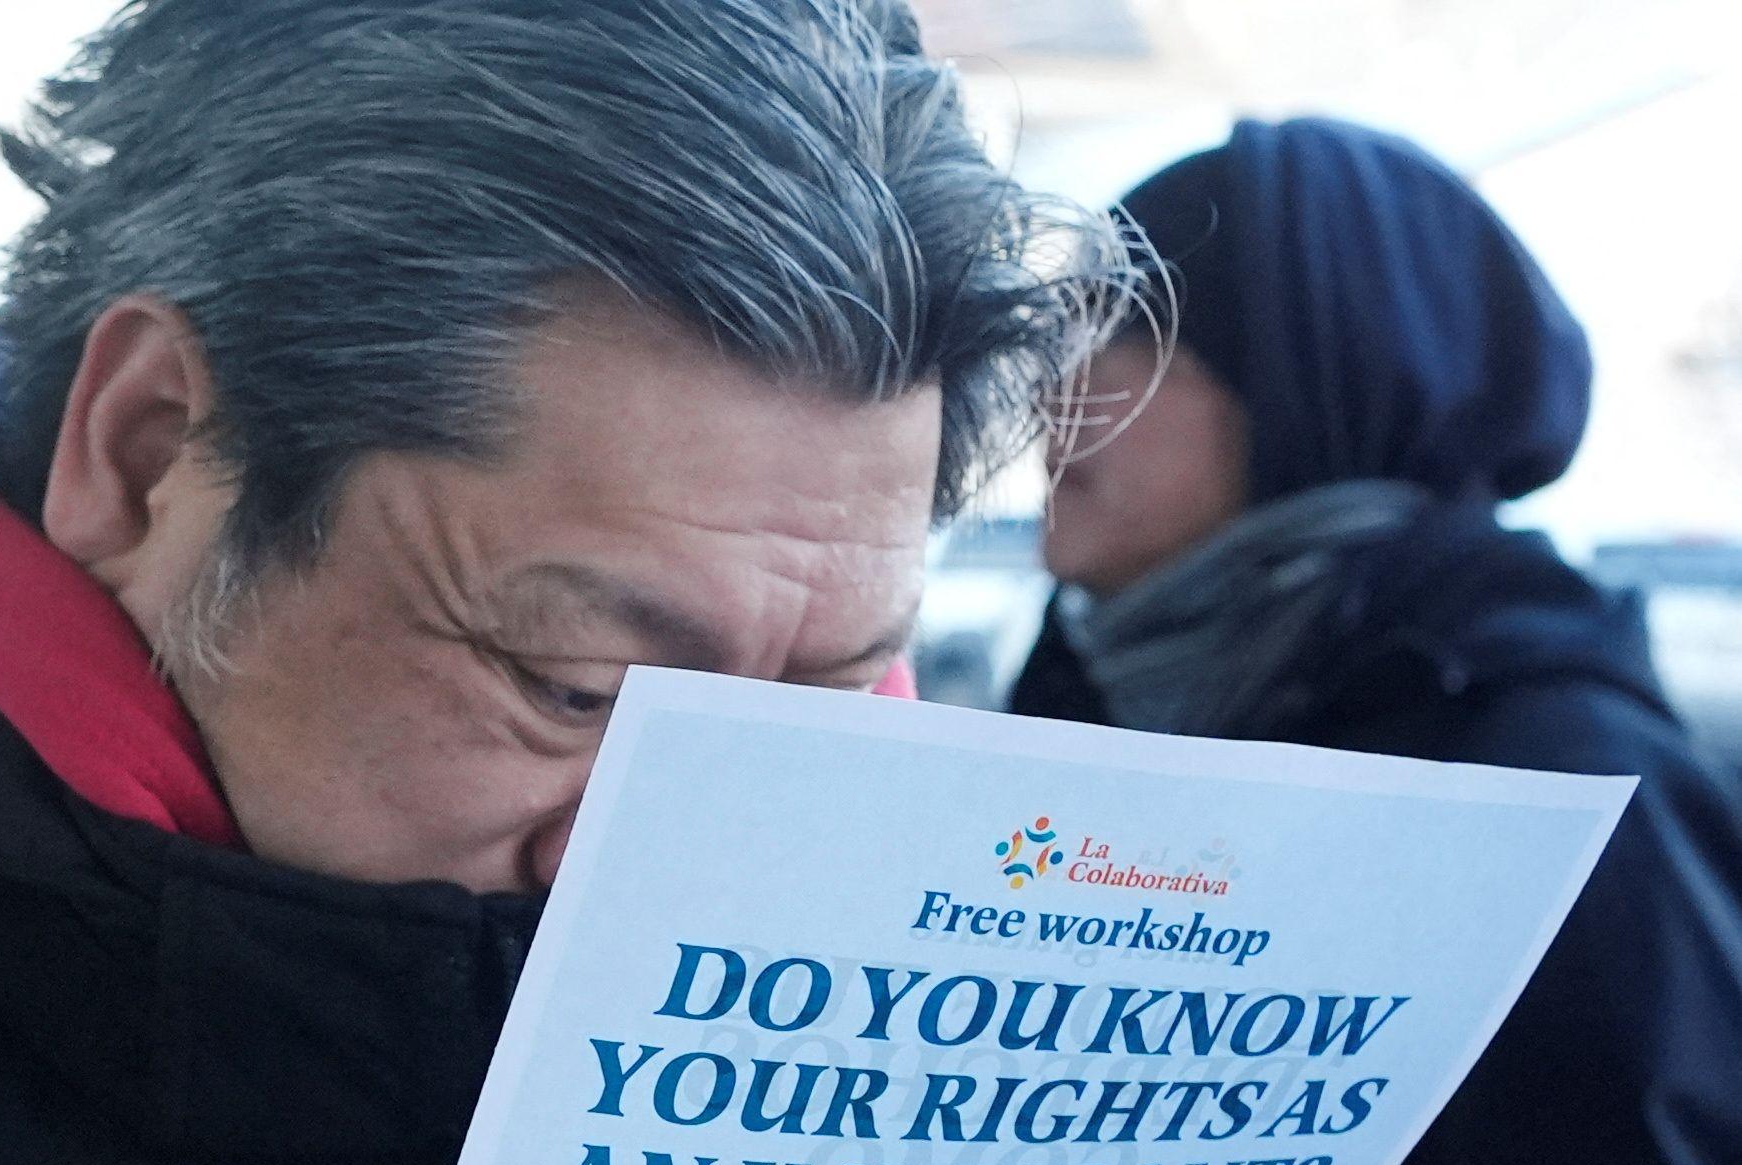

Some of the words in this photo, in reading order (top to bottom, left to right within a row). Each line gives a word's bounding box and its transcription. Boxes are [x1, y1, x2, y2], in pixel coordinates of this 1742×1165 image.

[1068, 862, 1229, 896] Colaborativa
[1077, 836, 1110, 859] La
[912, 890, 1027, 939] Free
[1038, 907, 1271, 967] workshop
[653, 942, 834, 1034] DO
[858, 966, 1083, 1053] YOU
[1086, 993, 1411, 1058] KNOW
[588, 1038, 890, 1142] YOUR
[901, 1071, 1263, 1144] RIGHTS
[1258, 1076, 1389, 1139] AS
